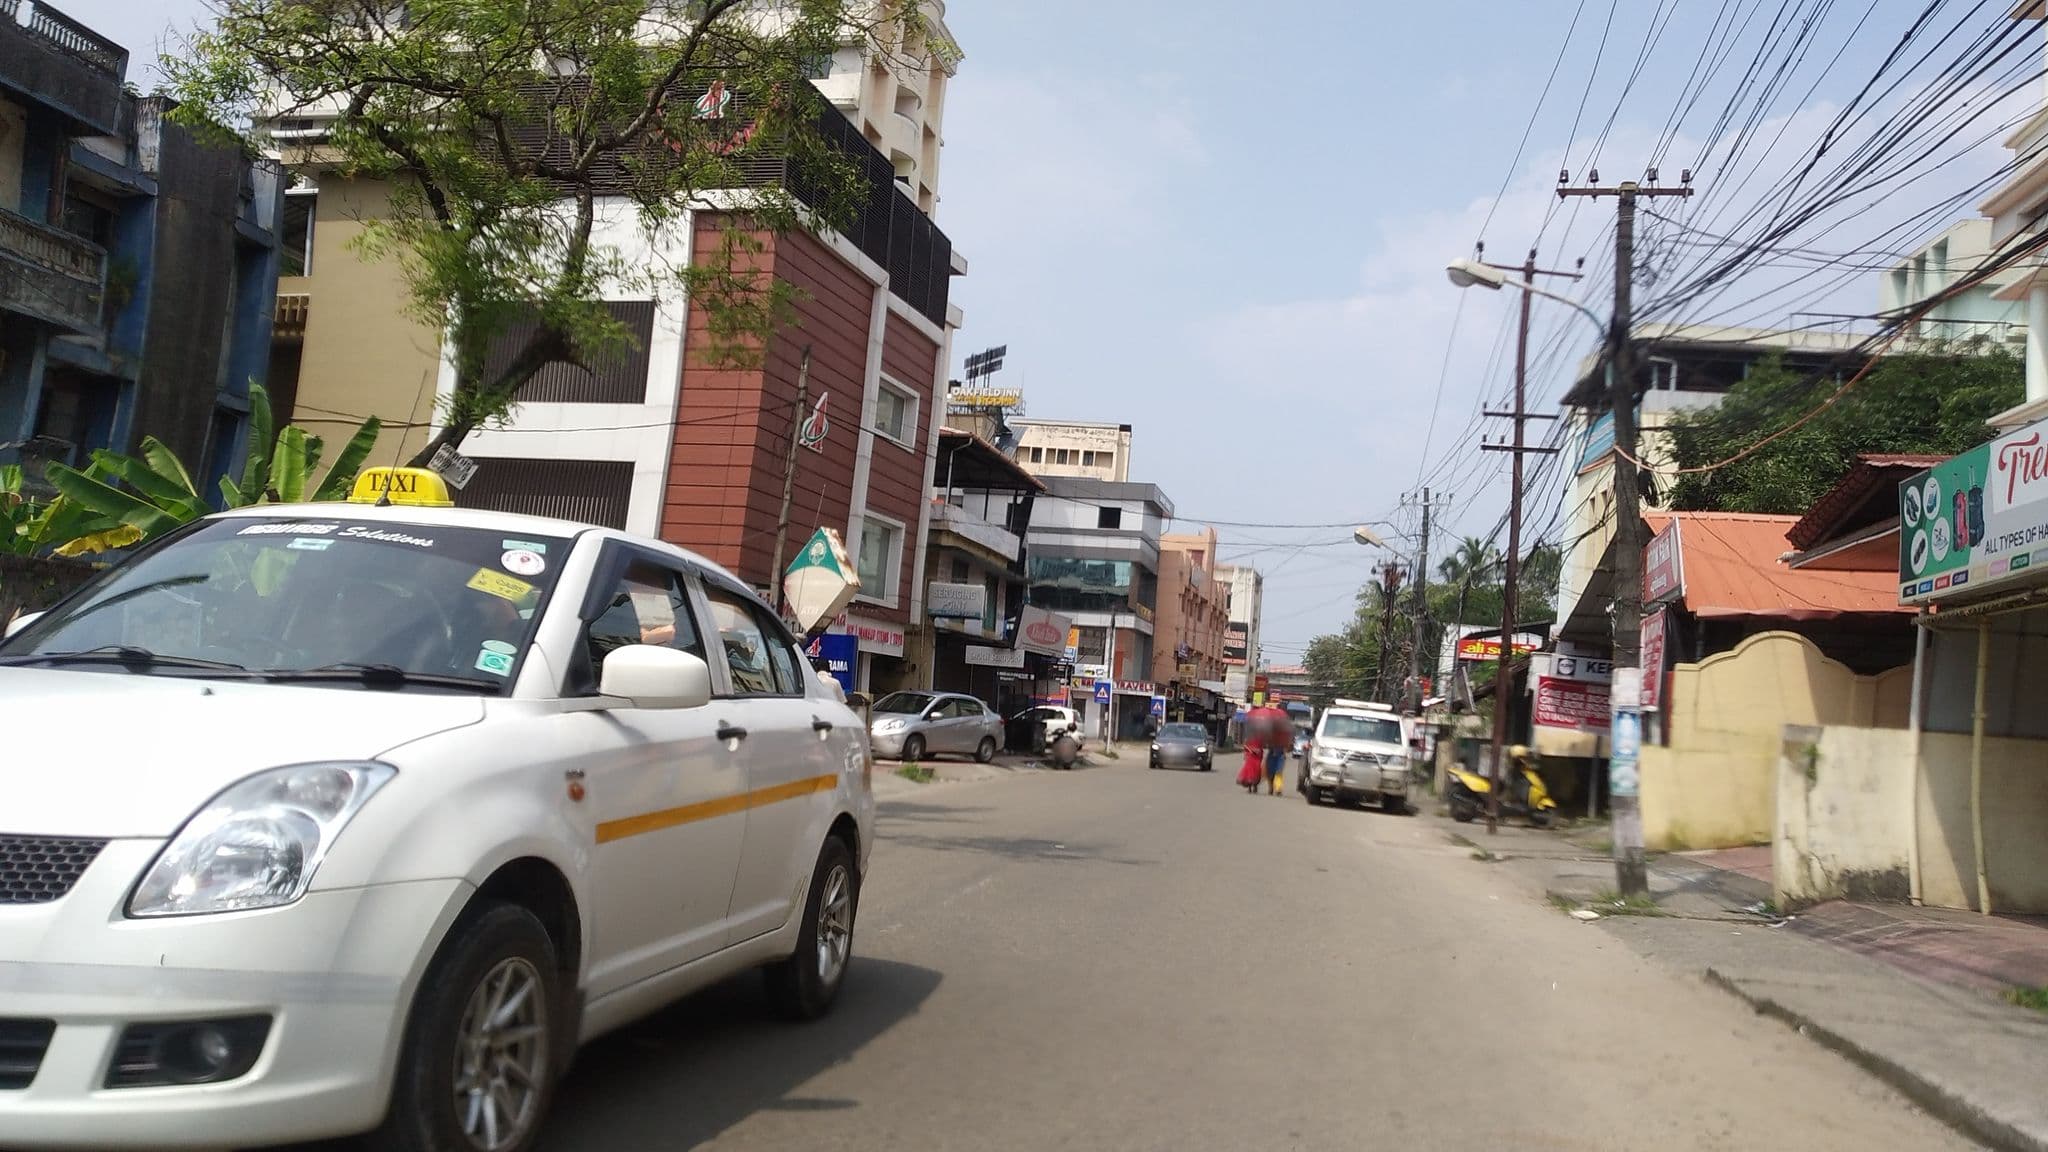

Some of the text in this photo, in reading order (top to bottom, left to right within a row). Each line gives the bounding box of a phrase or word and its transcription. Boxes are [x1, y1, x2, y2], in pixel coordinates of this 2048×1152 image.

[952, 387, 1020, 397] OAKFIELD INN
[368, 473, 417, 493] TAXI
[337, 526, 434, 547] Solutions
[1984, 538, 1998, 555] ALL
[1999, 530, 2024, 551] TYPES
[2025, 526, 2037, 543] OF
[1464, 642, 1484, 654] ali
